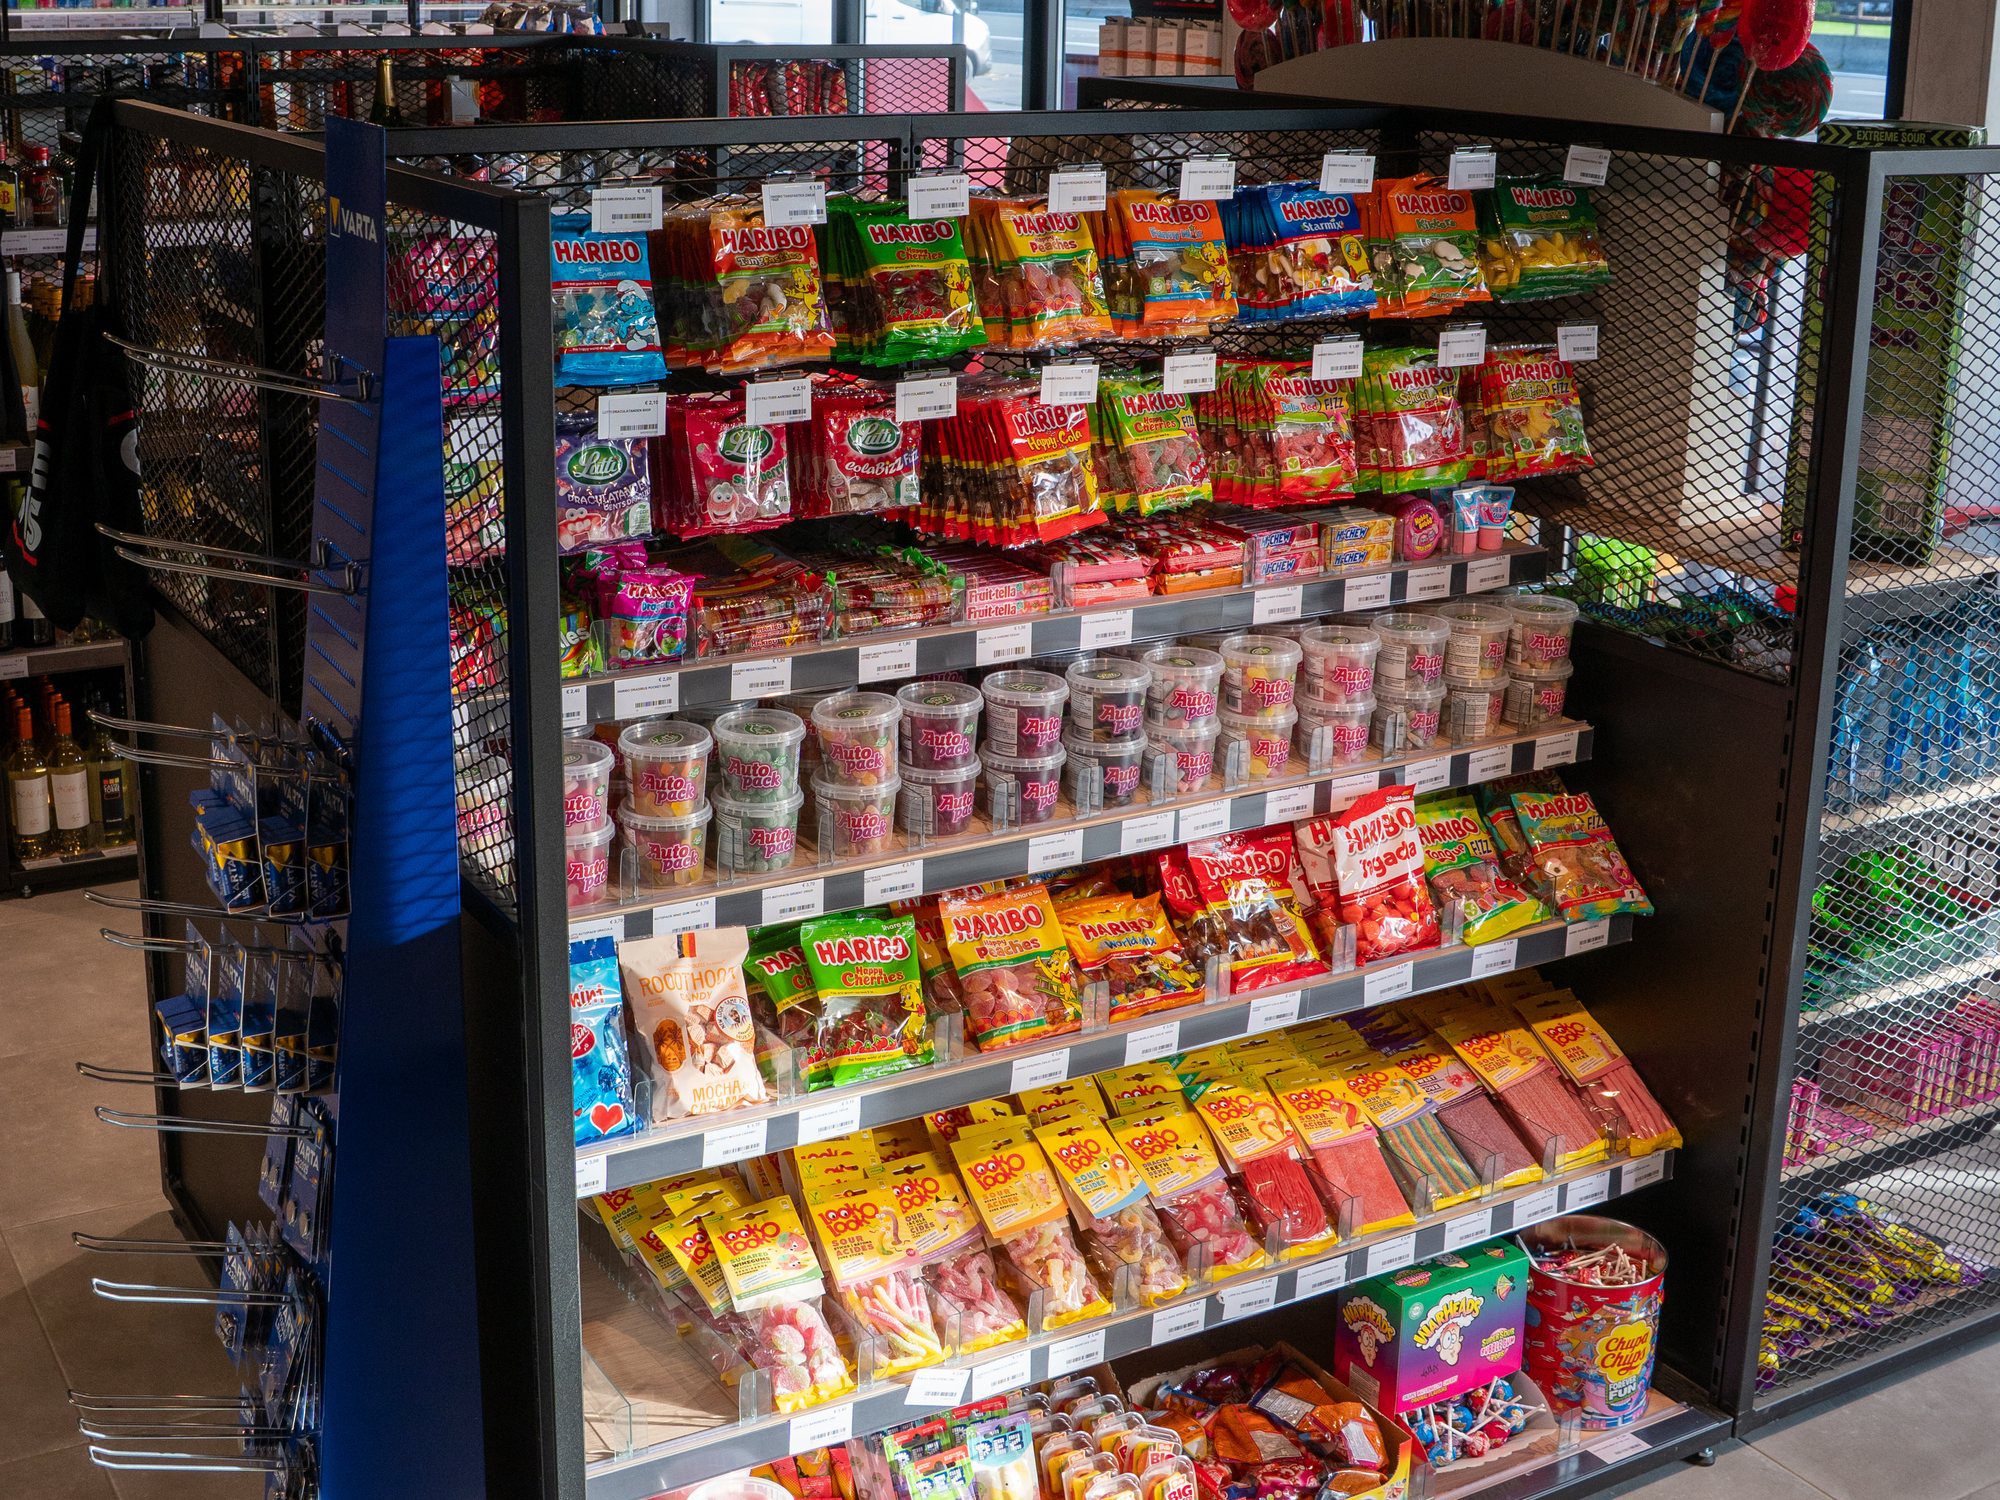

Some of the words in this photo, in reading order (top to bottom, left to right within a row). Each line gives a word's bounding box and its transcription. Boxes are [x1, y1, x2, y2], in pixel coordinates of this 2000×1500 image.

[1857, 129, 1899, 144] EXTREME
[1901, 131, 1926, 146] SOUR
[1281, 195, 1350, 223] HARIBO
[1397, 192, 1467, 215] HARIBO
[1512, 187, 1578, 209] HARIBO
[1011, 212, 1079, 237] HARIBO
[1131, 202, 1212, 225] HARIBO
[341, 207, 378, 244] VARTA
[867, 219, 955, 246] HARIBO
[1302, 219, 1343, 232] Starmix
[721, 224, 808, 252] HARIBO
[1029, 239, 1078, 254] Peaches
[552, 240, 643, 265] HARIBO
[896, 250, 944, 261] Cherries
[1388, 367, 1456, 392] HARIBO
[1500, 361, 1566, 384] HARIBO
[1270, 377, 1338, 400] HARIBO
[857, 420, 895, 449] Lutti
[1133, 420, 1176, 434] Cherries
[580, 450, 623, 478] Lutti
[1530, 632, 1566, 651] Auto
[1331, 664, 1372, 684] Auto
[1345, 673, 1375, 696] pack
[1249, 677, 1289, 695] Auto
[1263, 684, 1295, 708] pack
[1170, 689, 1210, 709] Auto
[1185, 697, 1217, 722] pack
[1023, 715, 1062, 735] Auto
[1332, 724, 1368, 743] Auto
[919, 728, 962, 747] Auto
[1254, 738, 1289, 757] Auto
[829, 742, 874, 762] Auto
[934, 737, 970, 762] pack
[1176, 751, 1213, 770] Auto
[725, 754, 768, 777] Auto
[844, 751, 885, 776] pack
[638, 771, 684, 793] Auto
[737, 764, 778, 790] pack
[1104, 765, 1140, 786] Auto
[653, 780, 694, 804] pack
[1023, 780, 1059, 800] Auto
[937, 791, 975, 812] Auto
[836, 810, 882, 830] Auto
[851, 817, 888, 843] pack
[1344, 806, 1417, 854] HARIBO
[745, 824, 789, 845] Auto
[643, 840, 687, 862] Auto
[658, 847, 696, 871] pack
[1357, 841, 1418, 879] Tagada
[567, 856, 607, 878] Auto
[1202, 850, 1288, 881] HARIBO
[952, 902, 1045, 944] HARIBO
[1078, 917, 1156, 943] HARIBO
[813, 935, 912, 967] HARIBO
[975, 939, 1041, 963] Peaches
[840, 971, 905, 988] Cherries
[855, 966, 884, 977] Happy
[691, 1080, 742, 1104] MOCHA
[1223, 1126, 1250, 1138] LACES
[1074, 1170, 1101, 1186] SOUR
[1080, 1179, 1108, 1195] ACIDES
[981, 1189, 1010, 1202] SOUR
[986, 1196, 1020, 1211] ACIDES
[830, 1234, 864, 1248] SOUR
[835, 1243, 875, 1259] ACIDES
[729, 1251, 770, 1265] SUGARED
[731, 1257, 771, 1273] WINEGUMS
[1341, 1303, 1396, 1342] WARHEADS
[1415, 1292, 1484, 1347] WARHEADS
[1605, 1330, 1647, 1353] Chupa
[1600, 1346, 1648, 1375] Chups
[1607, 1384, 1637, 1402] FUN
[1608, 1375, 1635, 1391] FOREVER
[915, 1465, 967, 1498] PEZ
